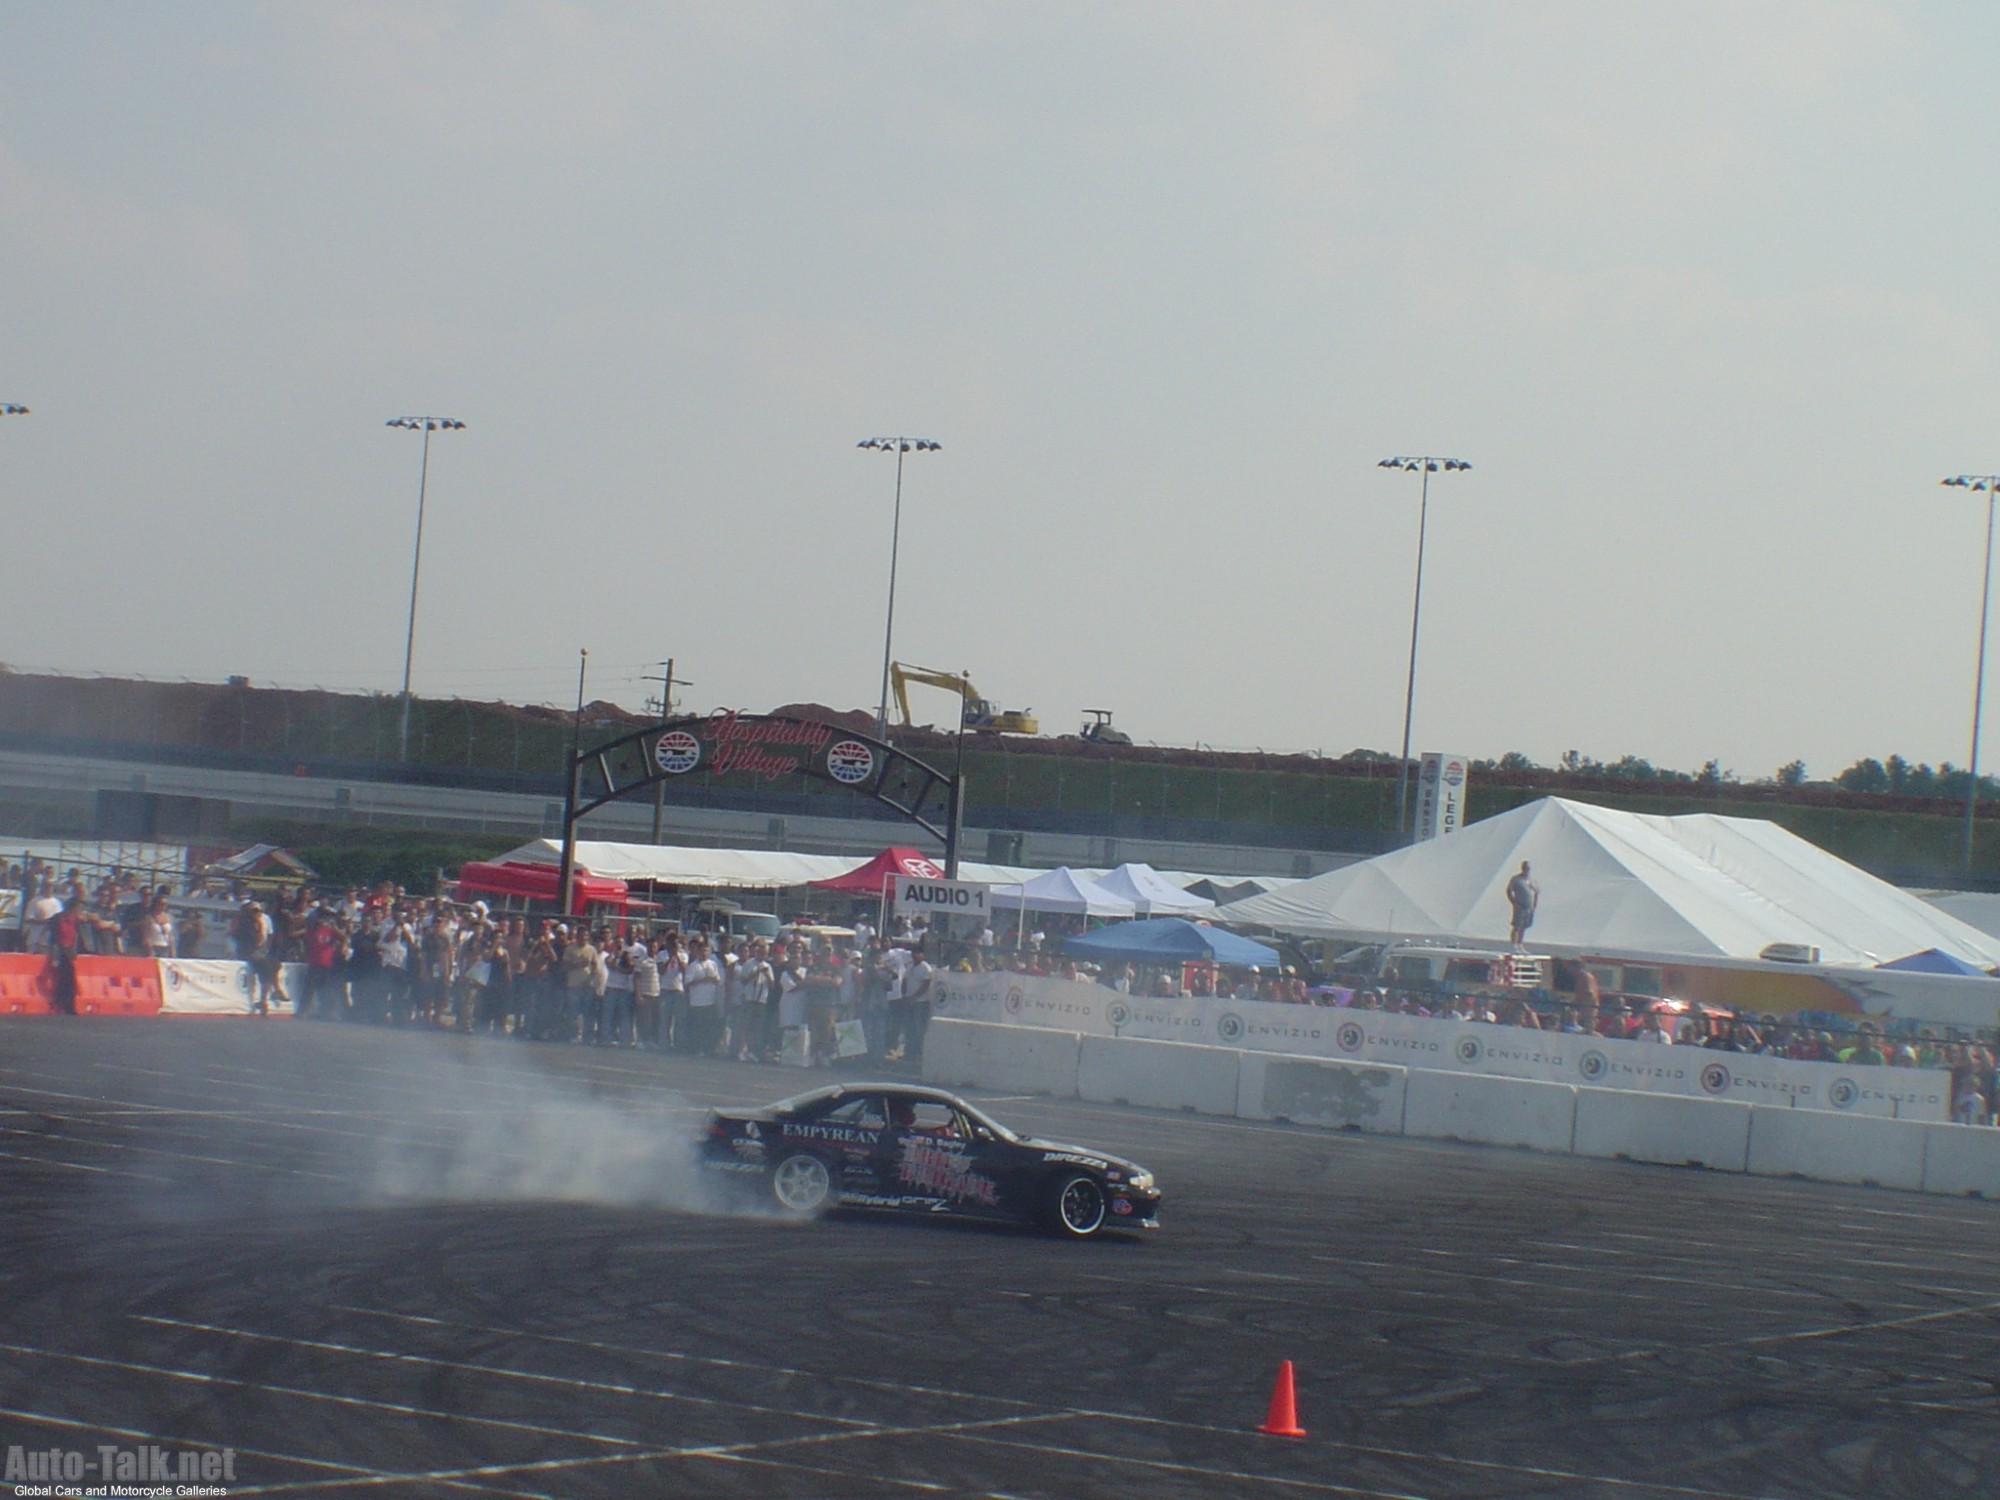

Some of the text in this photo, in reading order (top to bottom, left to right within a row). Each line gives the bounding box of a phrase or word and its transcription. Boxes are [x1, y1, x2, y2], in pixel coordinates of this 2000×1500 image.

[700, 707, 832, 753] Hospitality
[712, 742, 798, 780] Village
[905, 884, 984, 908] AUDIO 1
[1023, 1000, 1091, 1015] ENVIZIO
[1134, 1013, 1201, 1027] ENVIZIO
[1247, 1025, 1321, 1039] ENVIZIO
[1367, 1035, 1439, 1051] ENVIZIO
[1487, 1048, 1563, 1066] ENVIZIO
[1611, 1063, 1685, 1080] ENVIZIO
[1733, 1077, 1811, 1095] ENVIZIO
[1862, 1090, 1939, 1105] ENVIZIO
[782, 1123, 881, 1144] EMPYREAN
